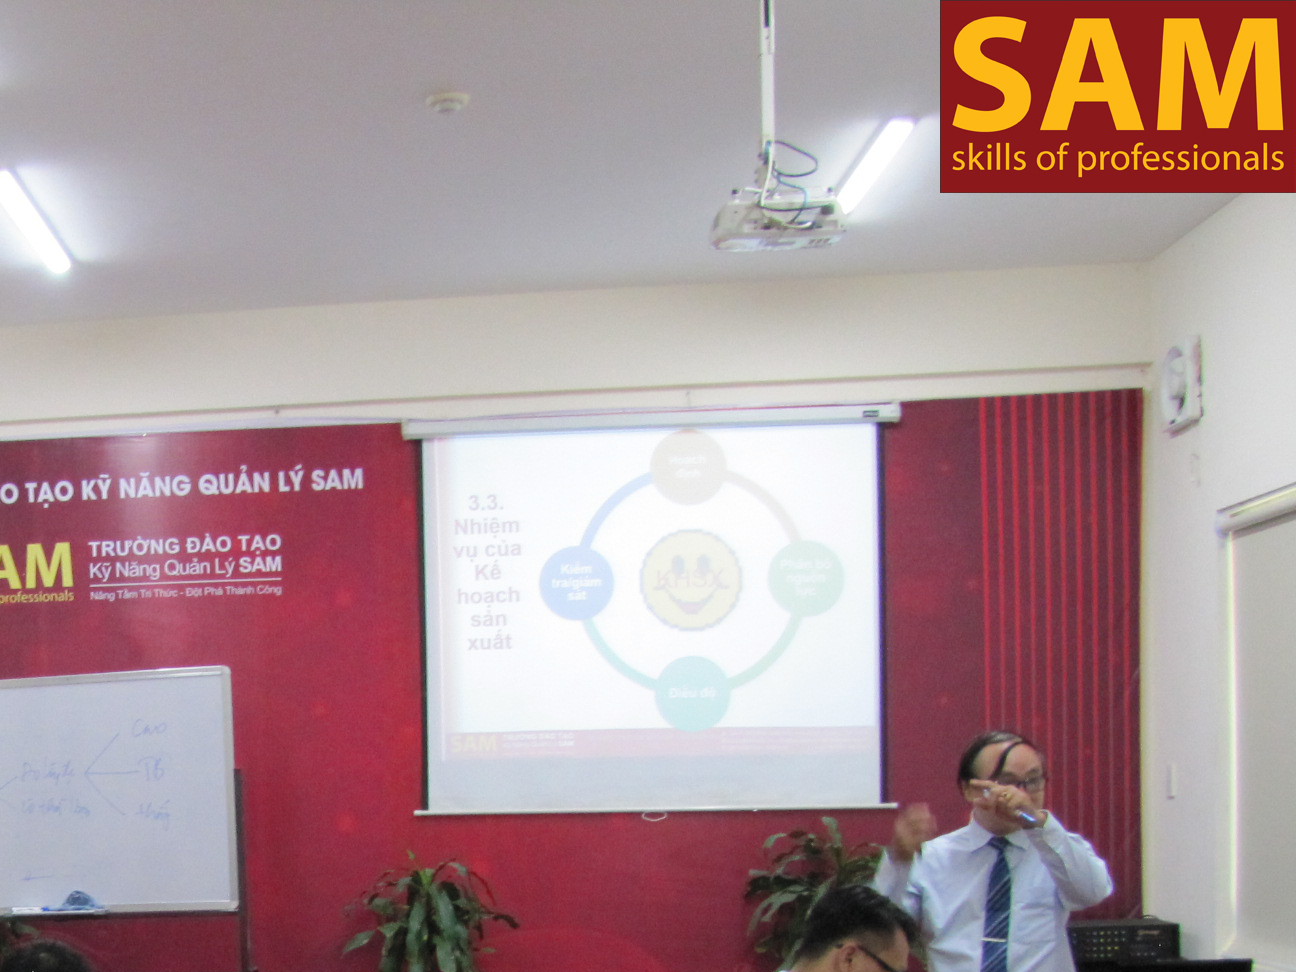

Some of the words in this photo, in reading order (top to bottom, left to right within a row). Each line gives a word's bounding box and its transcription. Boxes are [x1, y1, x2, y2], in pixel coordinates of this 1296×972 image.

[25, 480, 74, 508] TẠO
[81, 474, 111, 500] KỸ
[119, 472, 191, 499] NĂNG
[198, 465, 270, 495] QUẢN
[278, 464, 304, 492] LÝ
[311, 468, 364, 491] SAM
[468, 494, 504, 511] 3.3.
[454, 518, 520, 538] Nhiệm
[88, 536, 180, 557] TRƯỜNG
[186, 533, 232, 553] ĐÀO
[237, 534, 282, 555] TẠO
[453, 544, 477, 563] vụ
[485, 539, 522, 557] của
[89, 562, 112, 582] Kỹ
[116, 560, 160, 580] Năng
[164, 558, 210, 577] Quản
[215, 556, 235, 577] Lý
[239, 556, 282, 573] SAM
[474, 560, 502, 581] Kế
[457, 588, 520, 608] hoạch
[471, 609, 508, 628] sản
[467, 629, 513, 650] xuất
